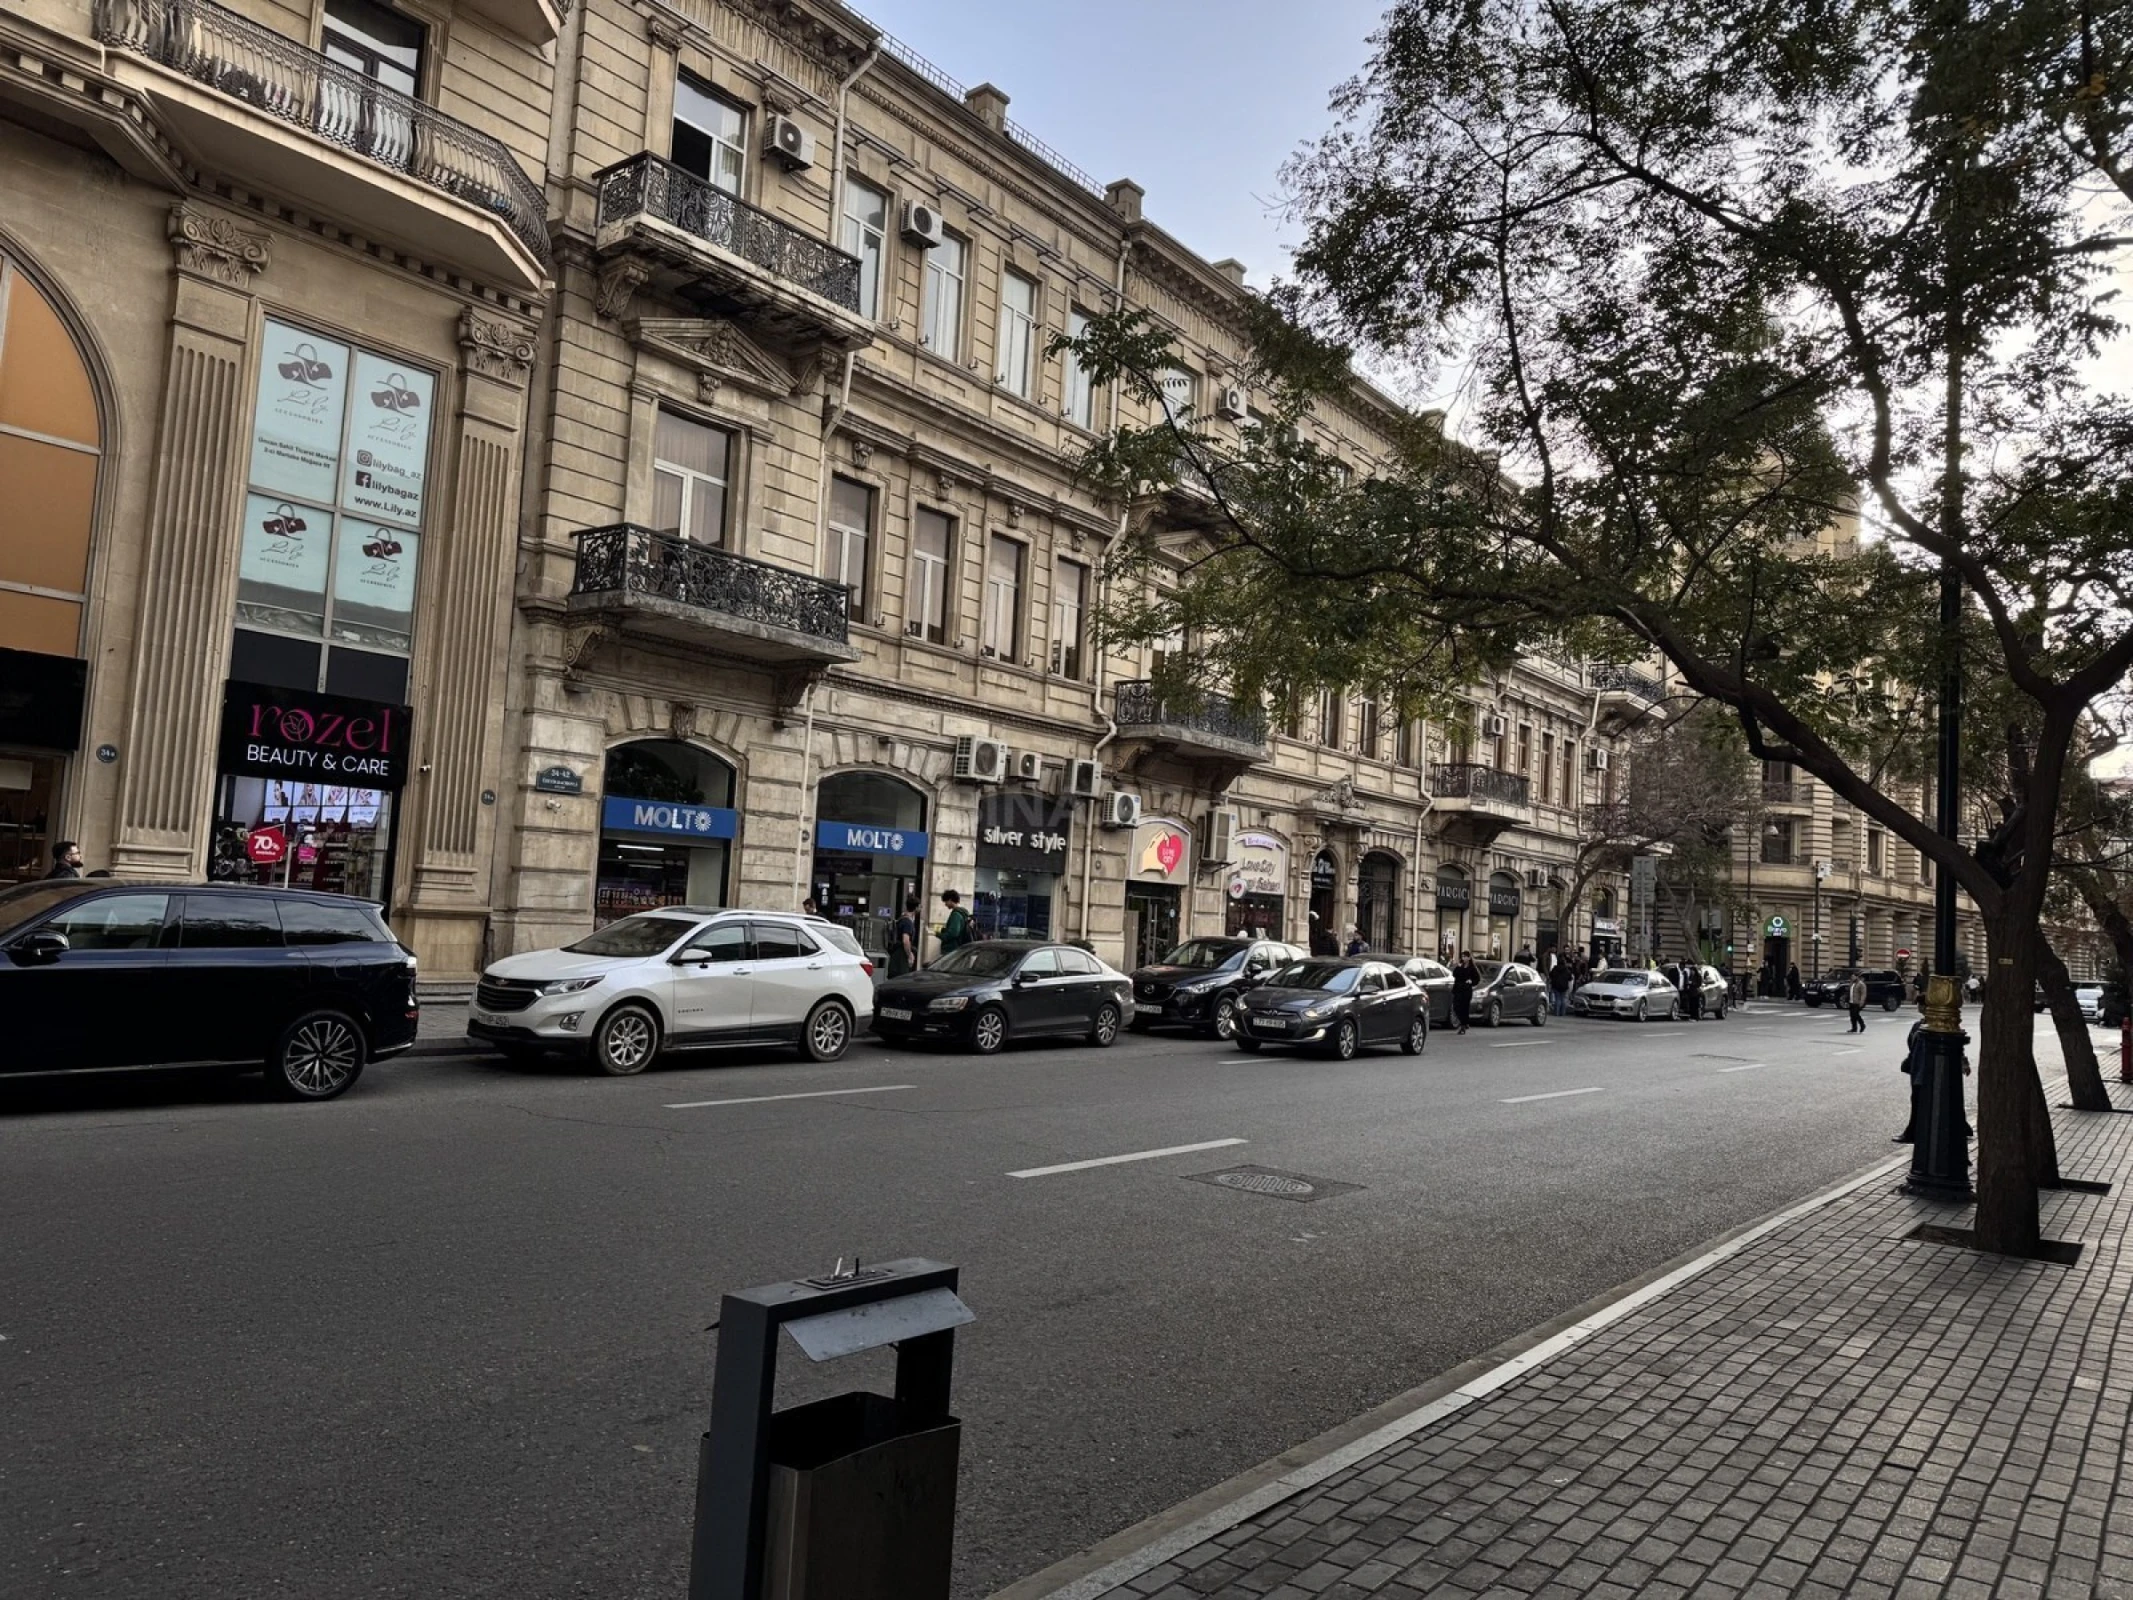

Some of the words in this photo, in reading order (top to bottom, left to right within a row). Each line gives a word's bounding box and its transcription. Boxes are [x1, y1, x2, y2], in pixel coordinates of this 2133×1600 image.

[373, 459, 421, 479] lilybag_az
[372, 481, 419, 500] lilybagaz
[354, 496, 416, 518] www.Lily.az
[248, 704, 391, 753] rozel
[247, 743, 318, 767] BEAUTY
[322, 753, 337, 771] &
[342, 755, 390, 777] CARE
[634, 804, 712, 832] MOLTO
[254, 835, 280, 851] 70%
[847, 828, 905, 851] MOLTO
[983, 826, 1024, 846] silver
[1030, 831, 1067, 854] style
